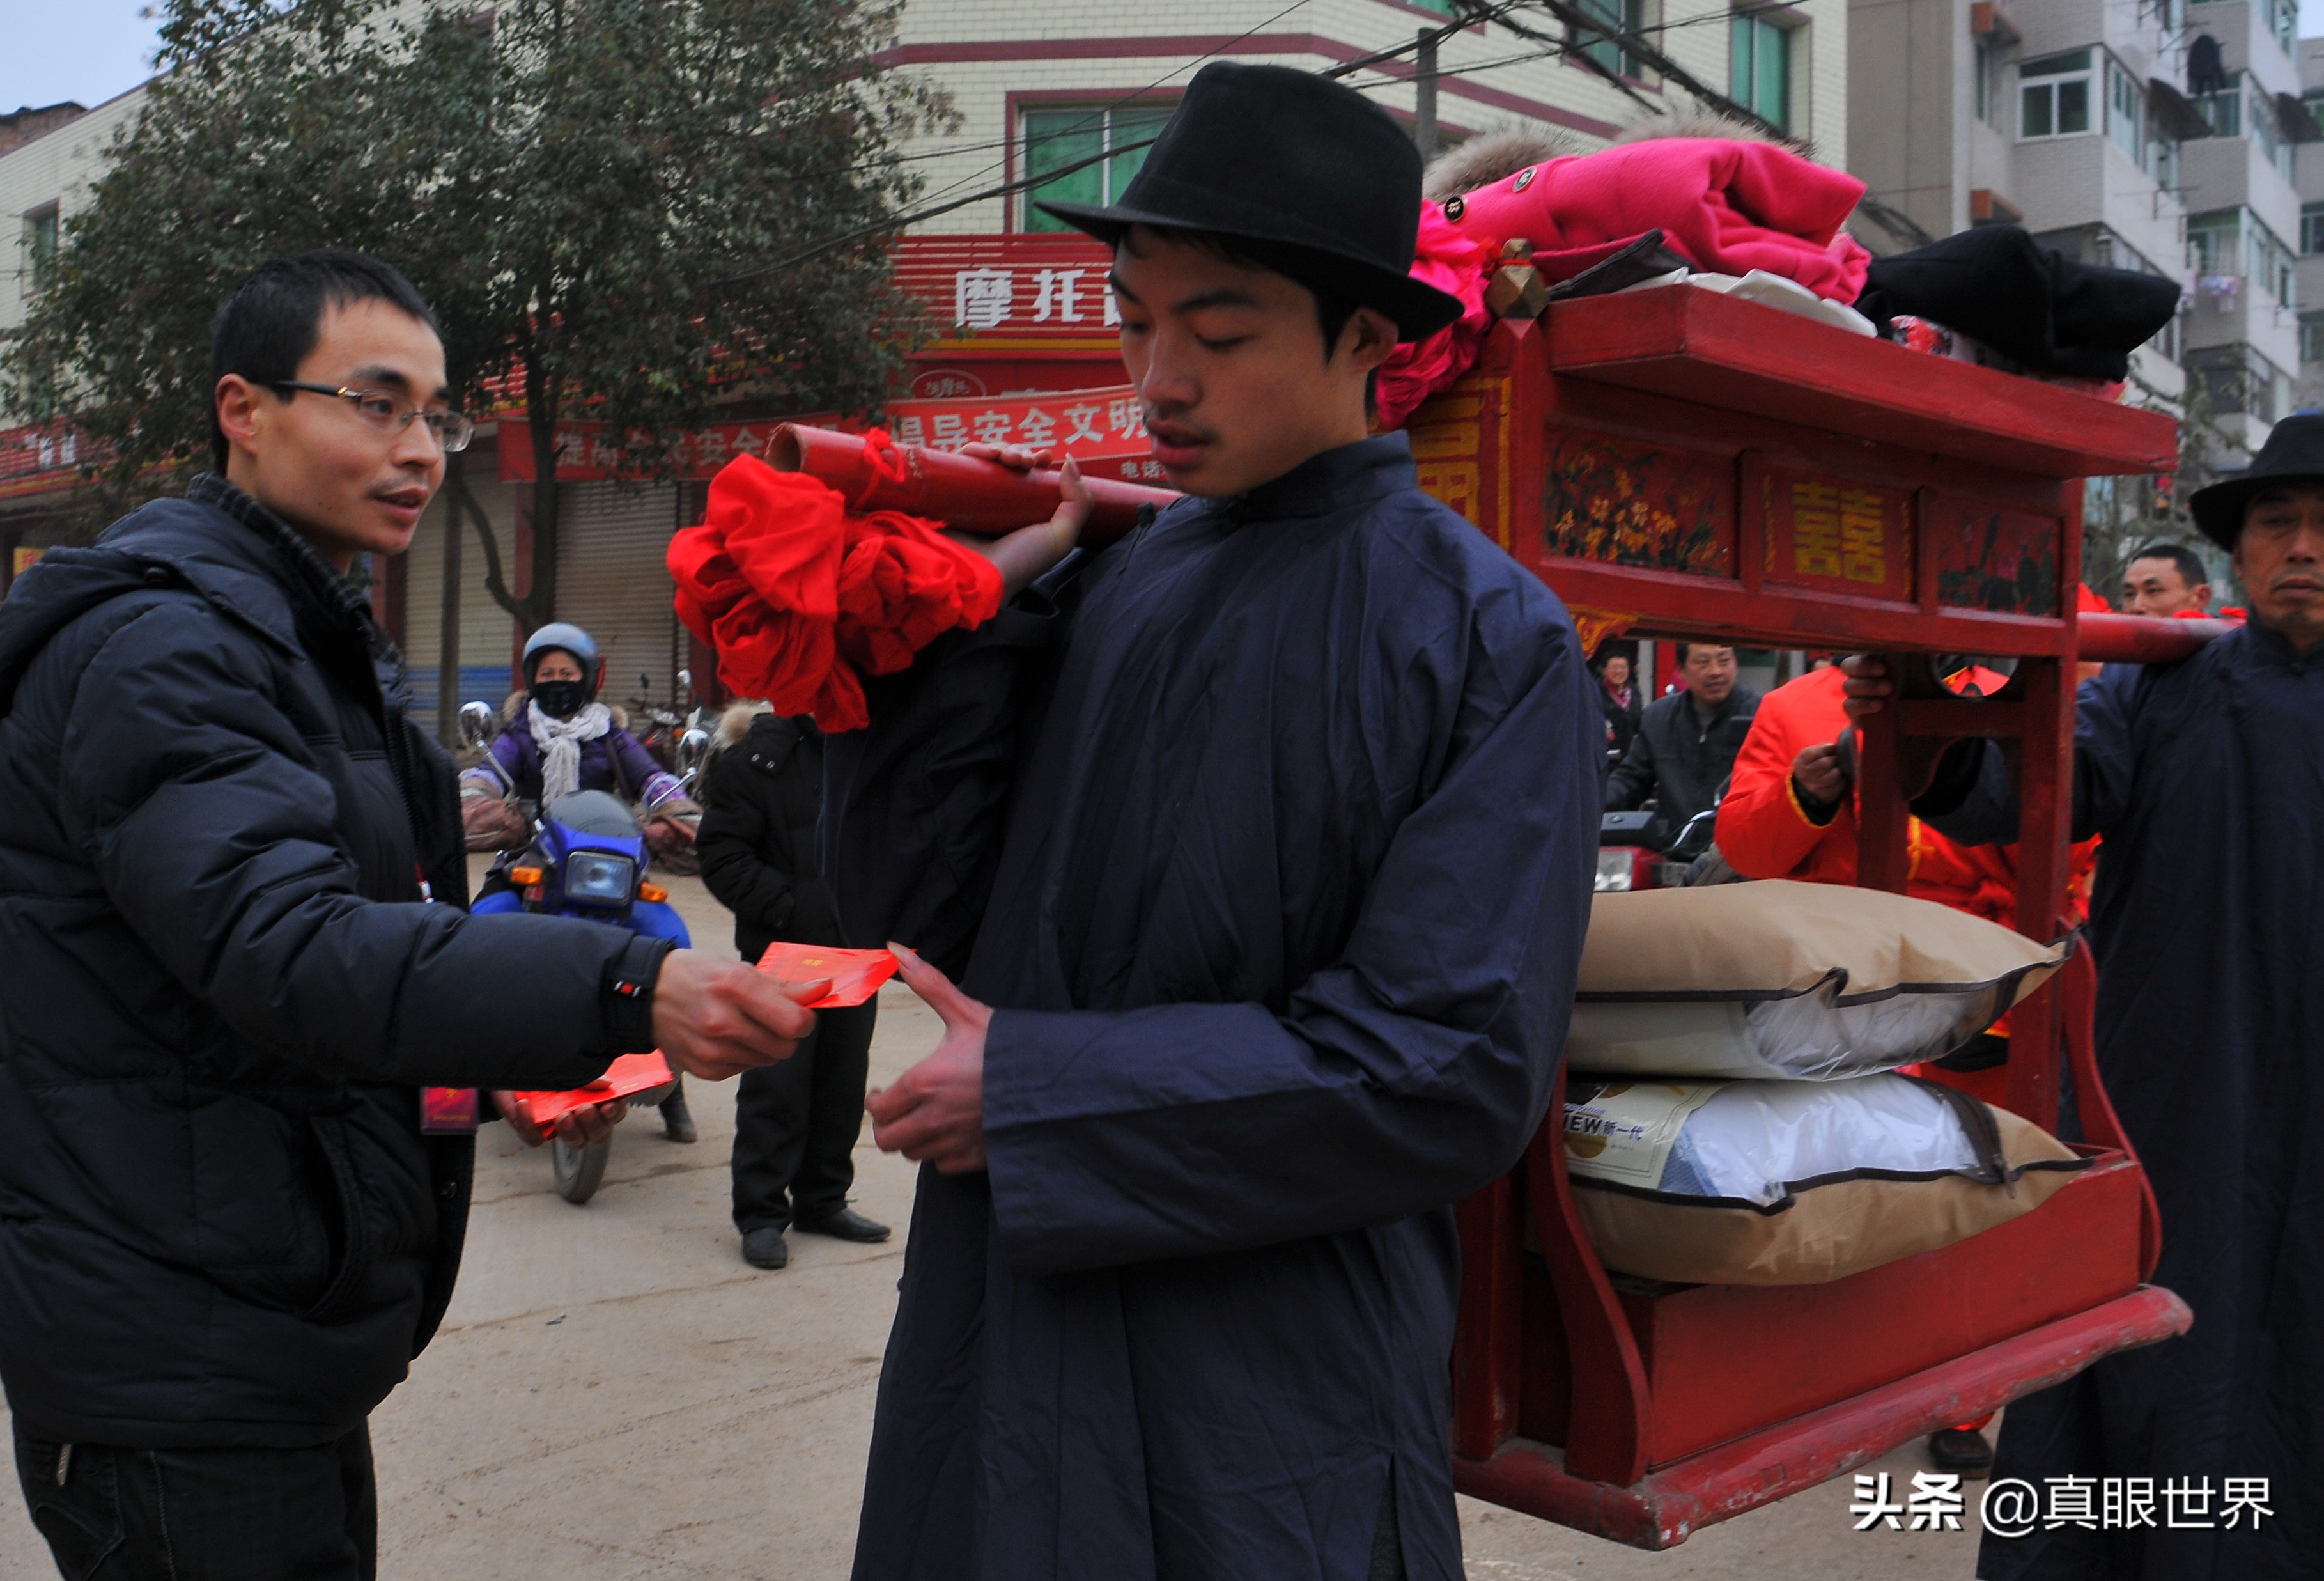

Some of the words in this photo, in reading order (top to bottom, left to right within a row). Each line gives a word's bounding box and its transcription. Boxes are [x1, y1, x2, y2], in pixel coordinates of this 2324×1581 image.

[956, 266, 1122, 329] 摩托
[1603, 1121, 1644, 1141] 新一代
